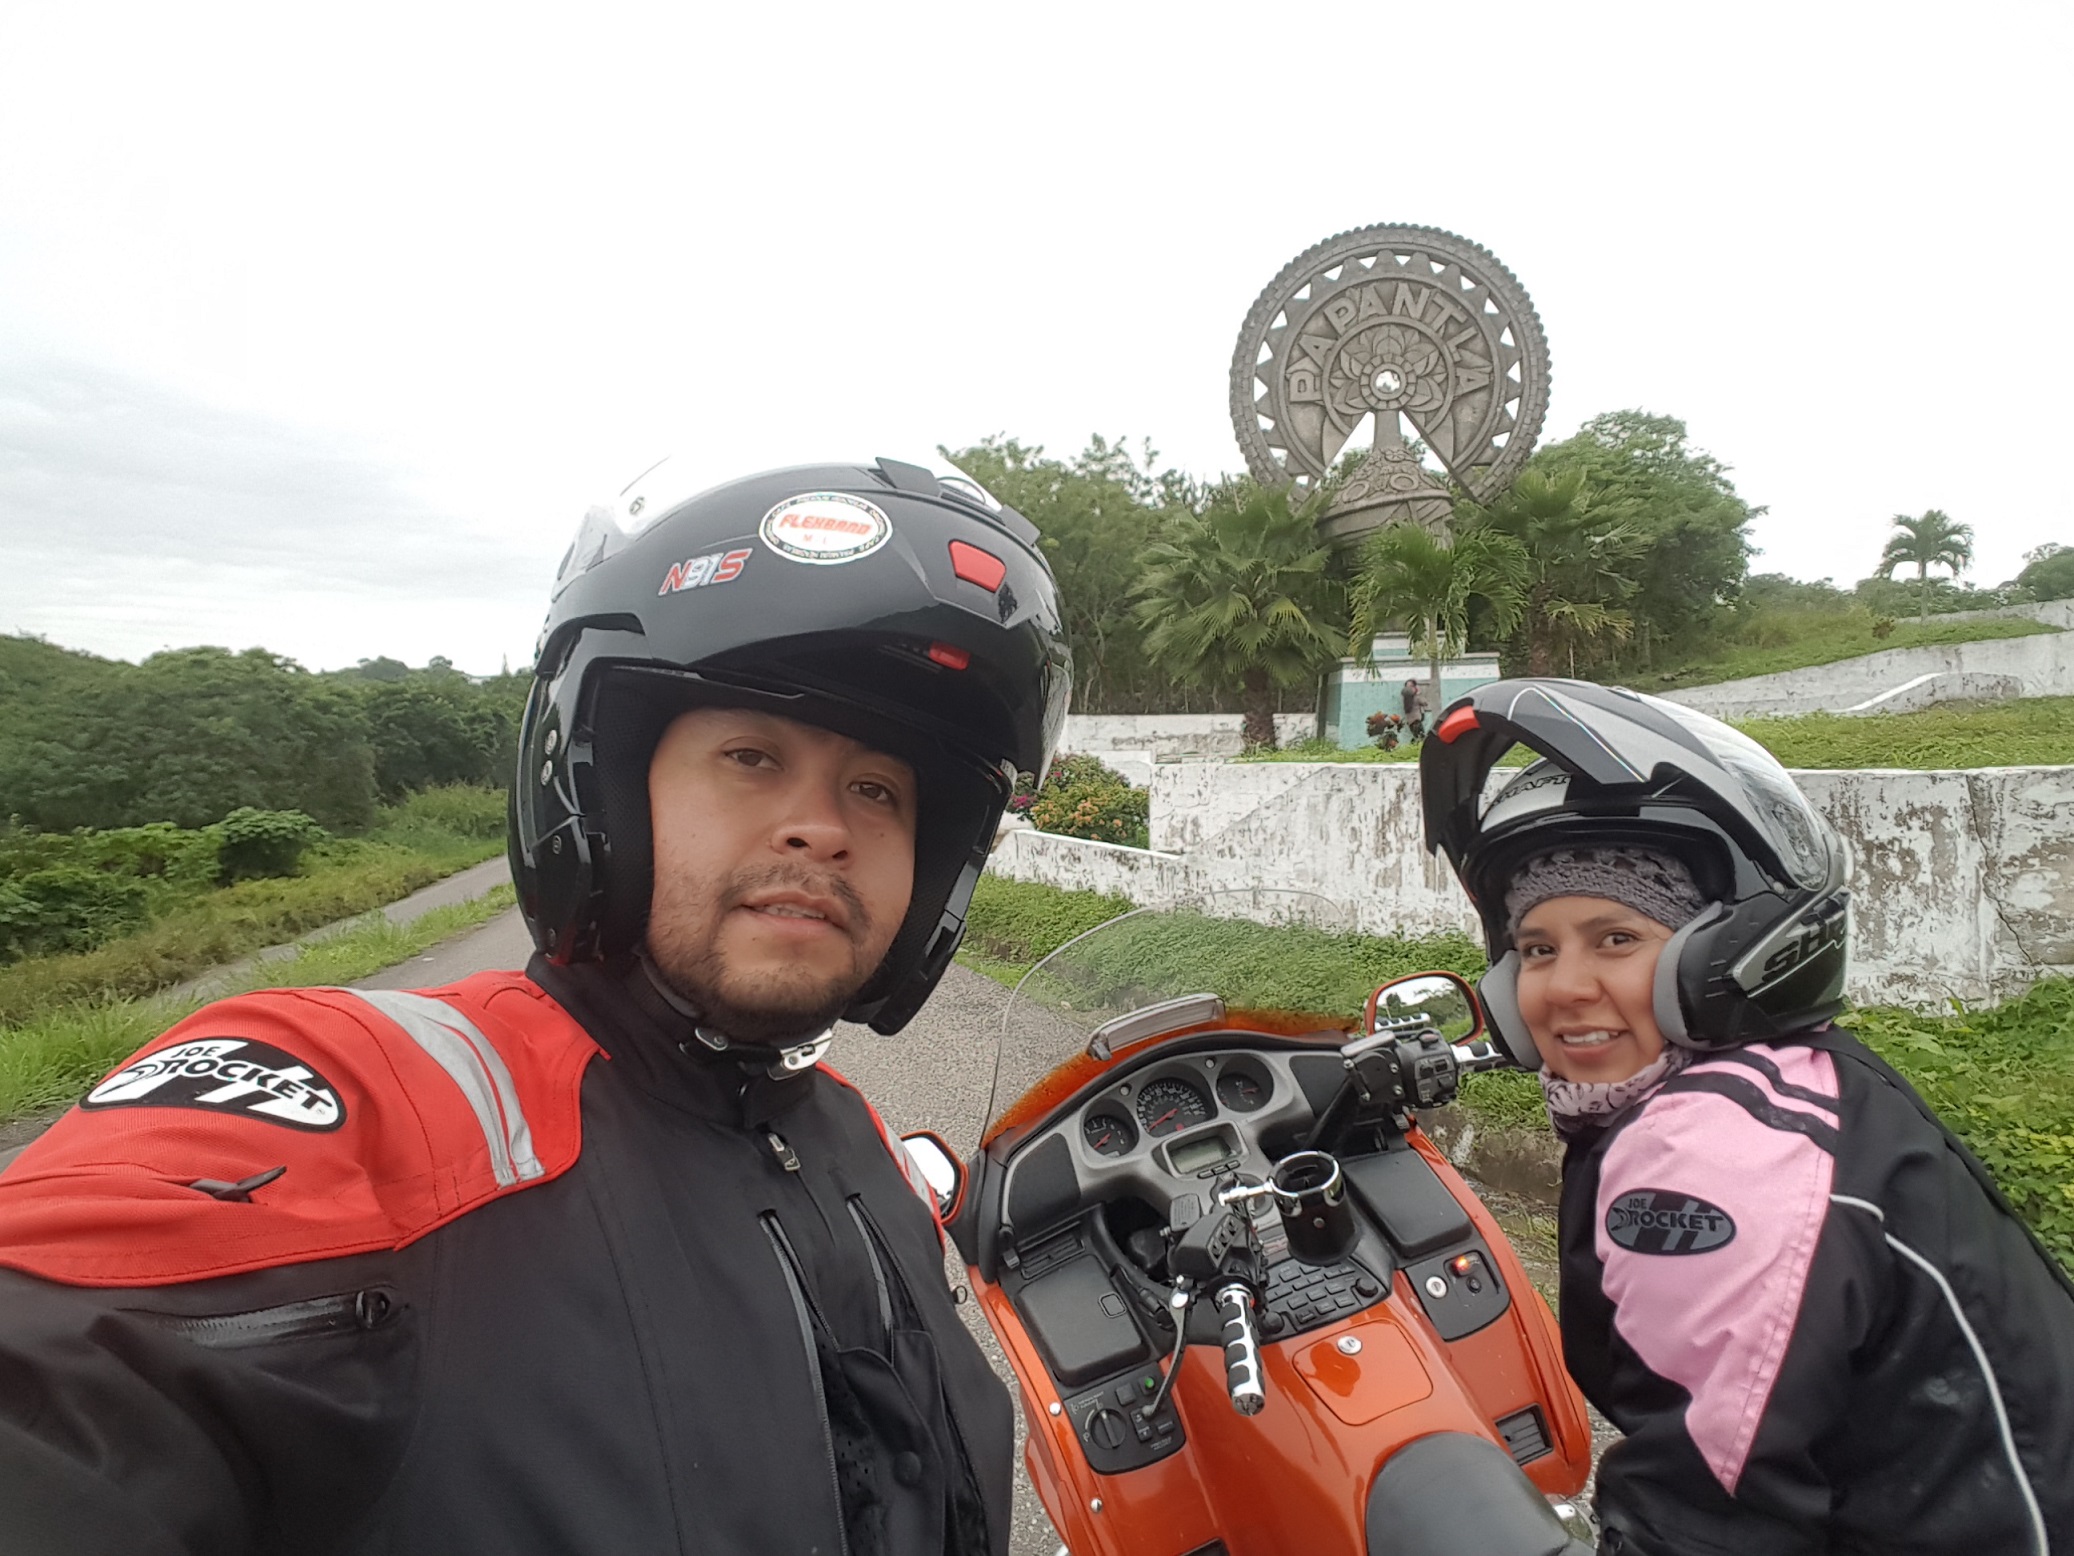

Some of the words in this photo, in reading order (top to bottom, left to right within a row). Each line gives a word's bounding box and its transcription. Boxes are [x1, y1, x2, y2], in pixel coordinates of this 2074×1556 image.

[1287, 282, 1493, 402] PAPANTLA
[778, 513, 873, 536] FLEXBAND
[170, 1045, 221, 1059] JOE
[157, 1057, 334, 1111] ROCKET
[1628, 1197, 1649, 1210] JOE
[1627, 1209, 1724, 1232] ROCKET
